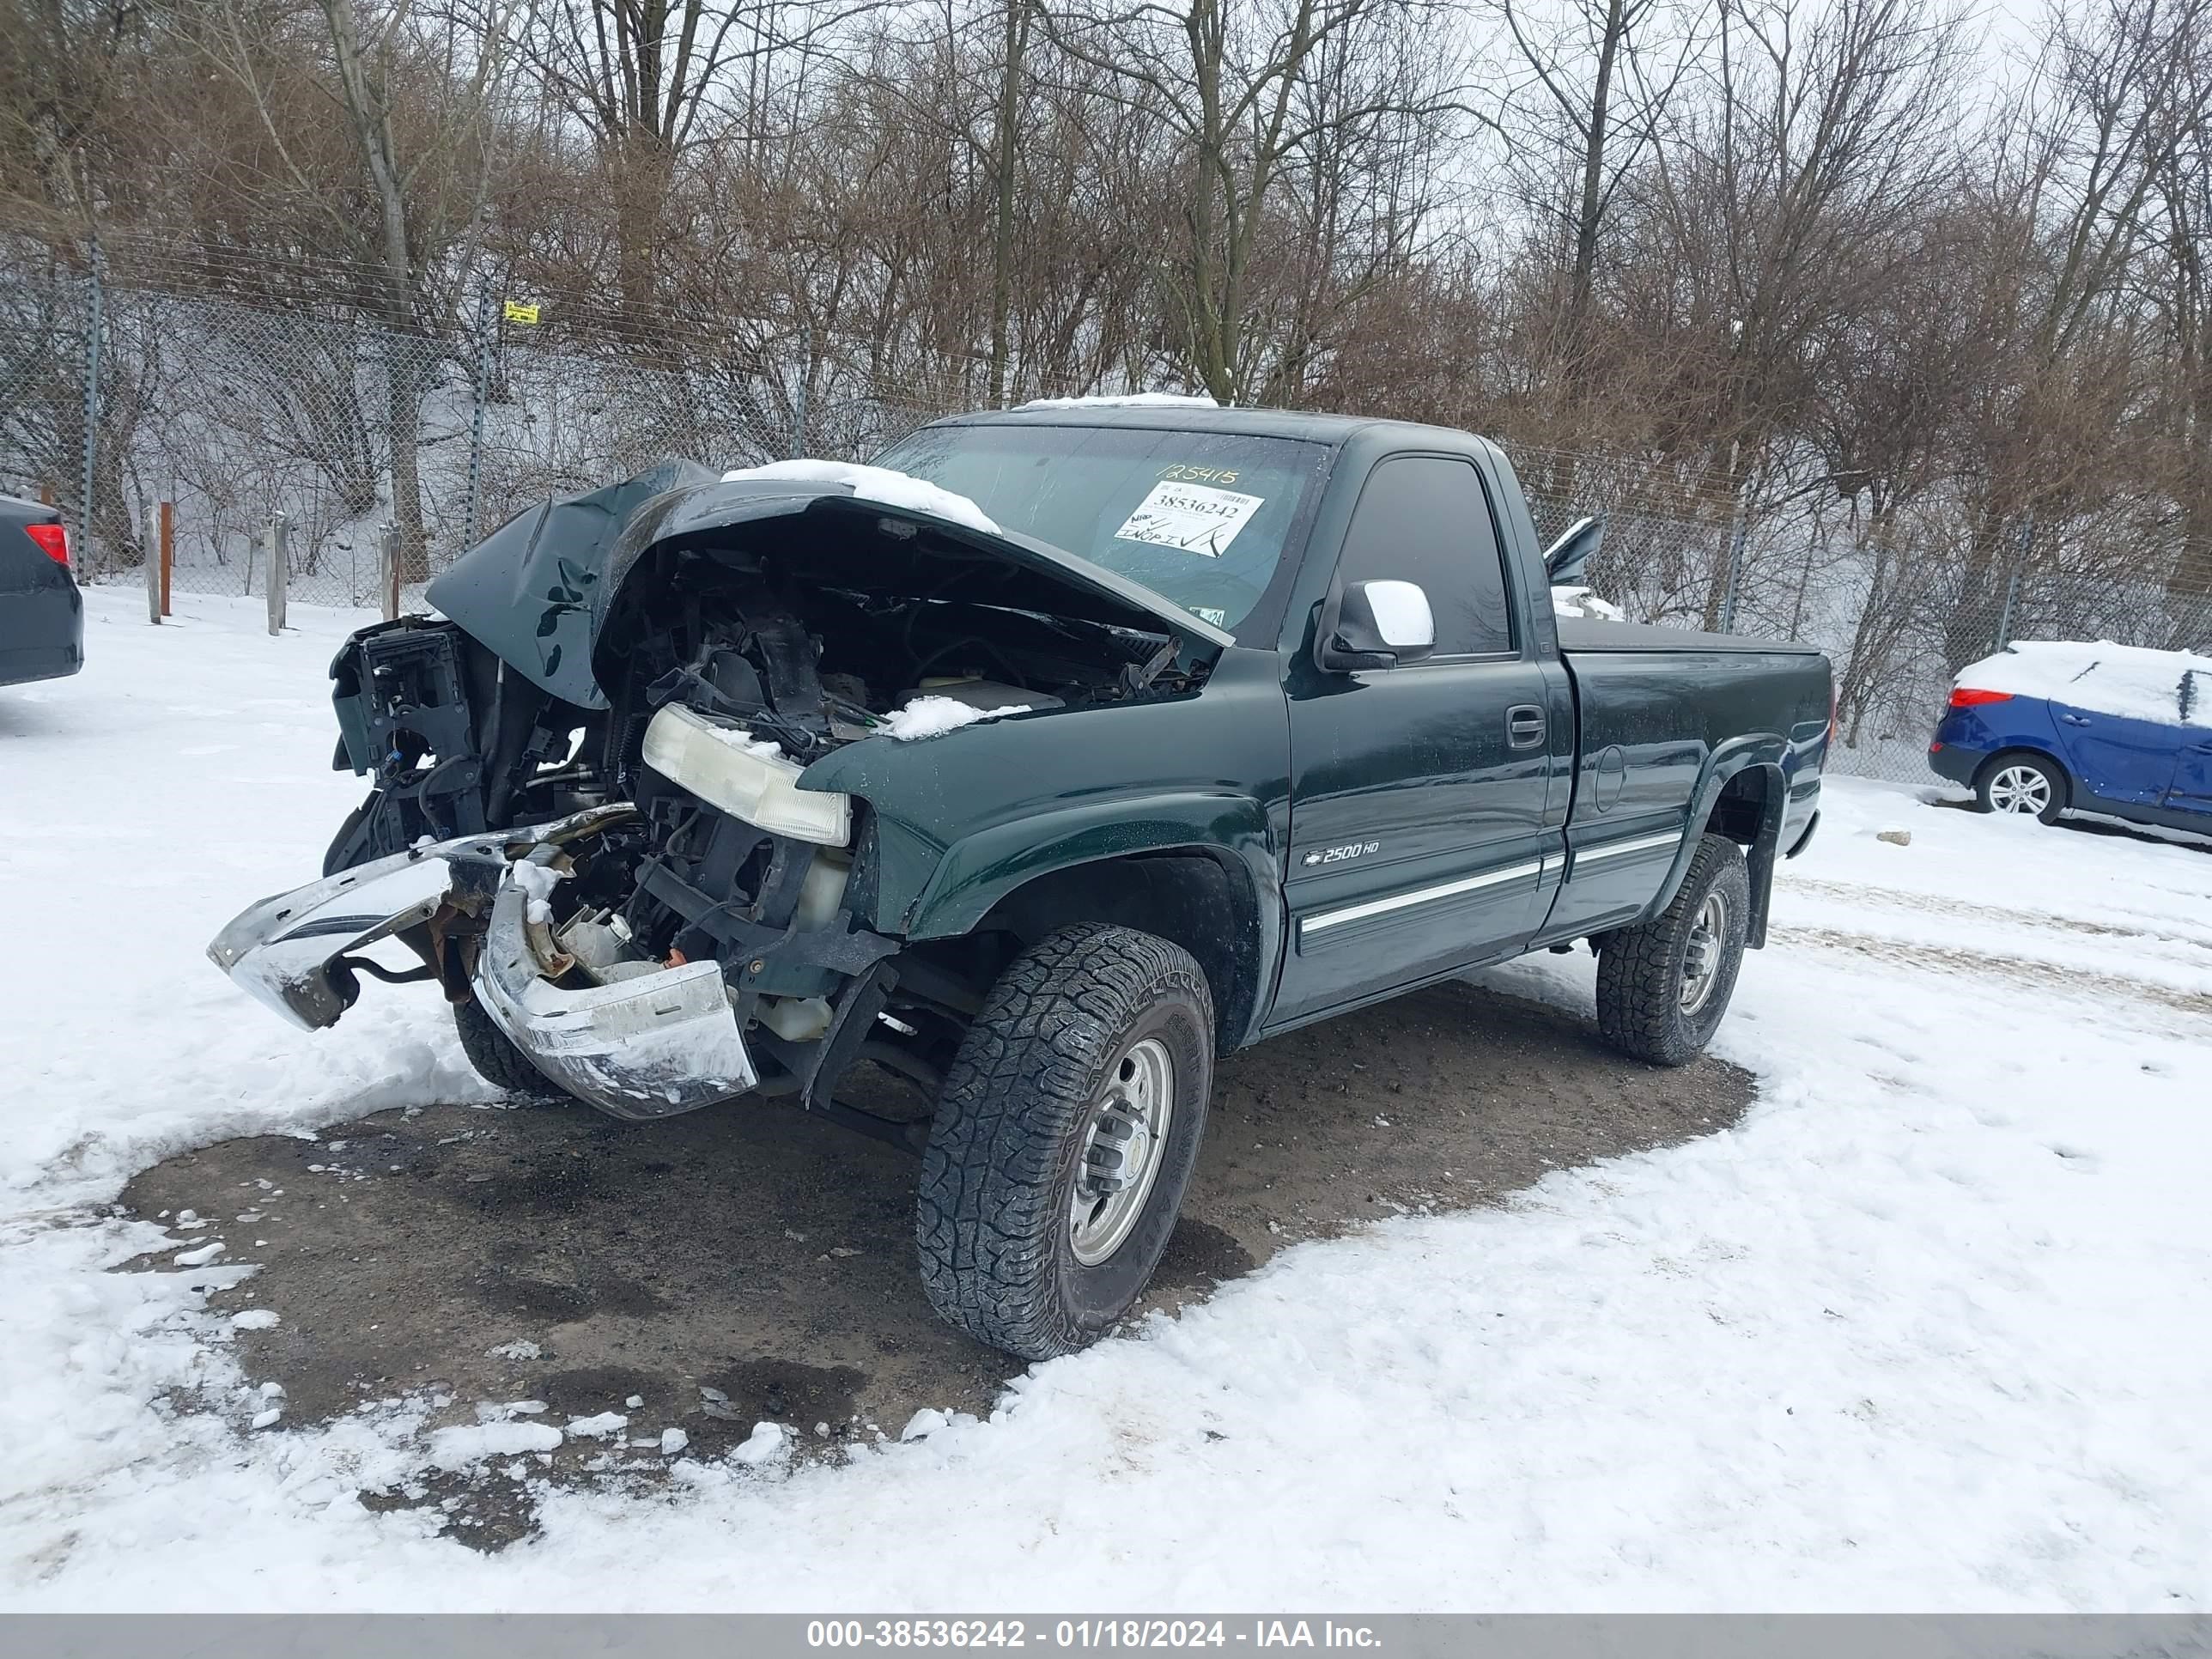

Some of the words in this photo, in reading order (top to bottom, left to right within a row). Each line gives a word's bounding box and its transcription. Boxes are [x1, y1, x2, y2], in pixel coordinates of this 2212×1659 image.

[1153, 495, 1239, 519] 38536242
[1323, 844, 1362, 863] 2500
[1363, 842, 1380, 854] HD
